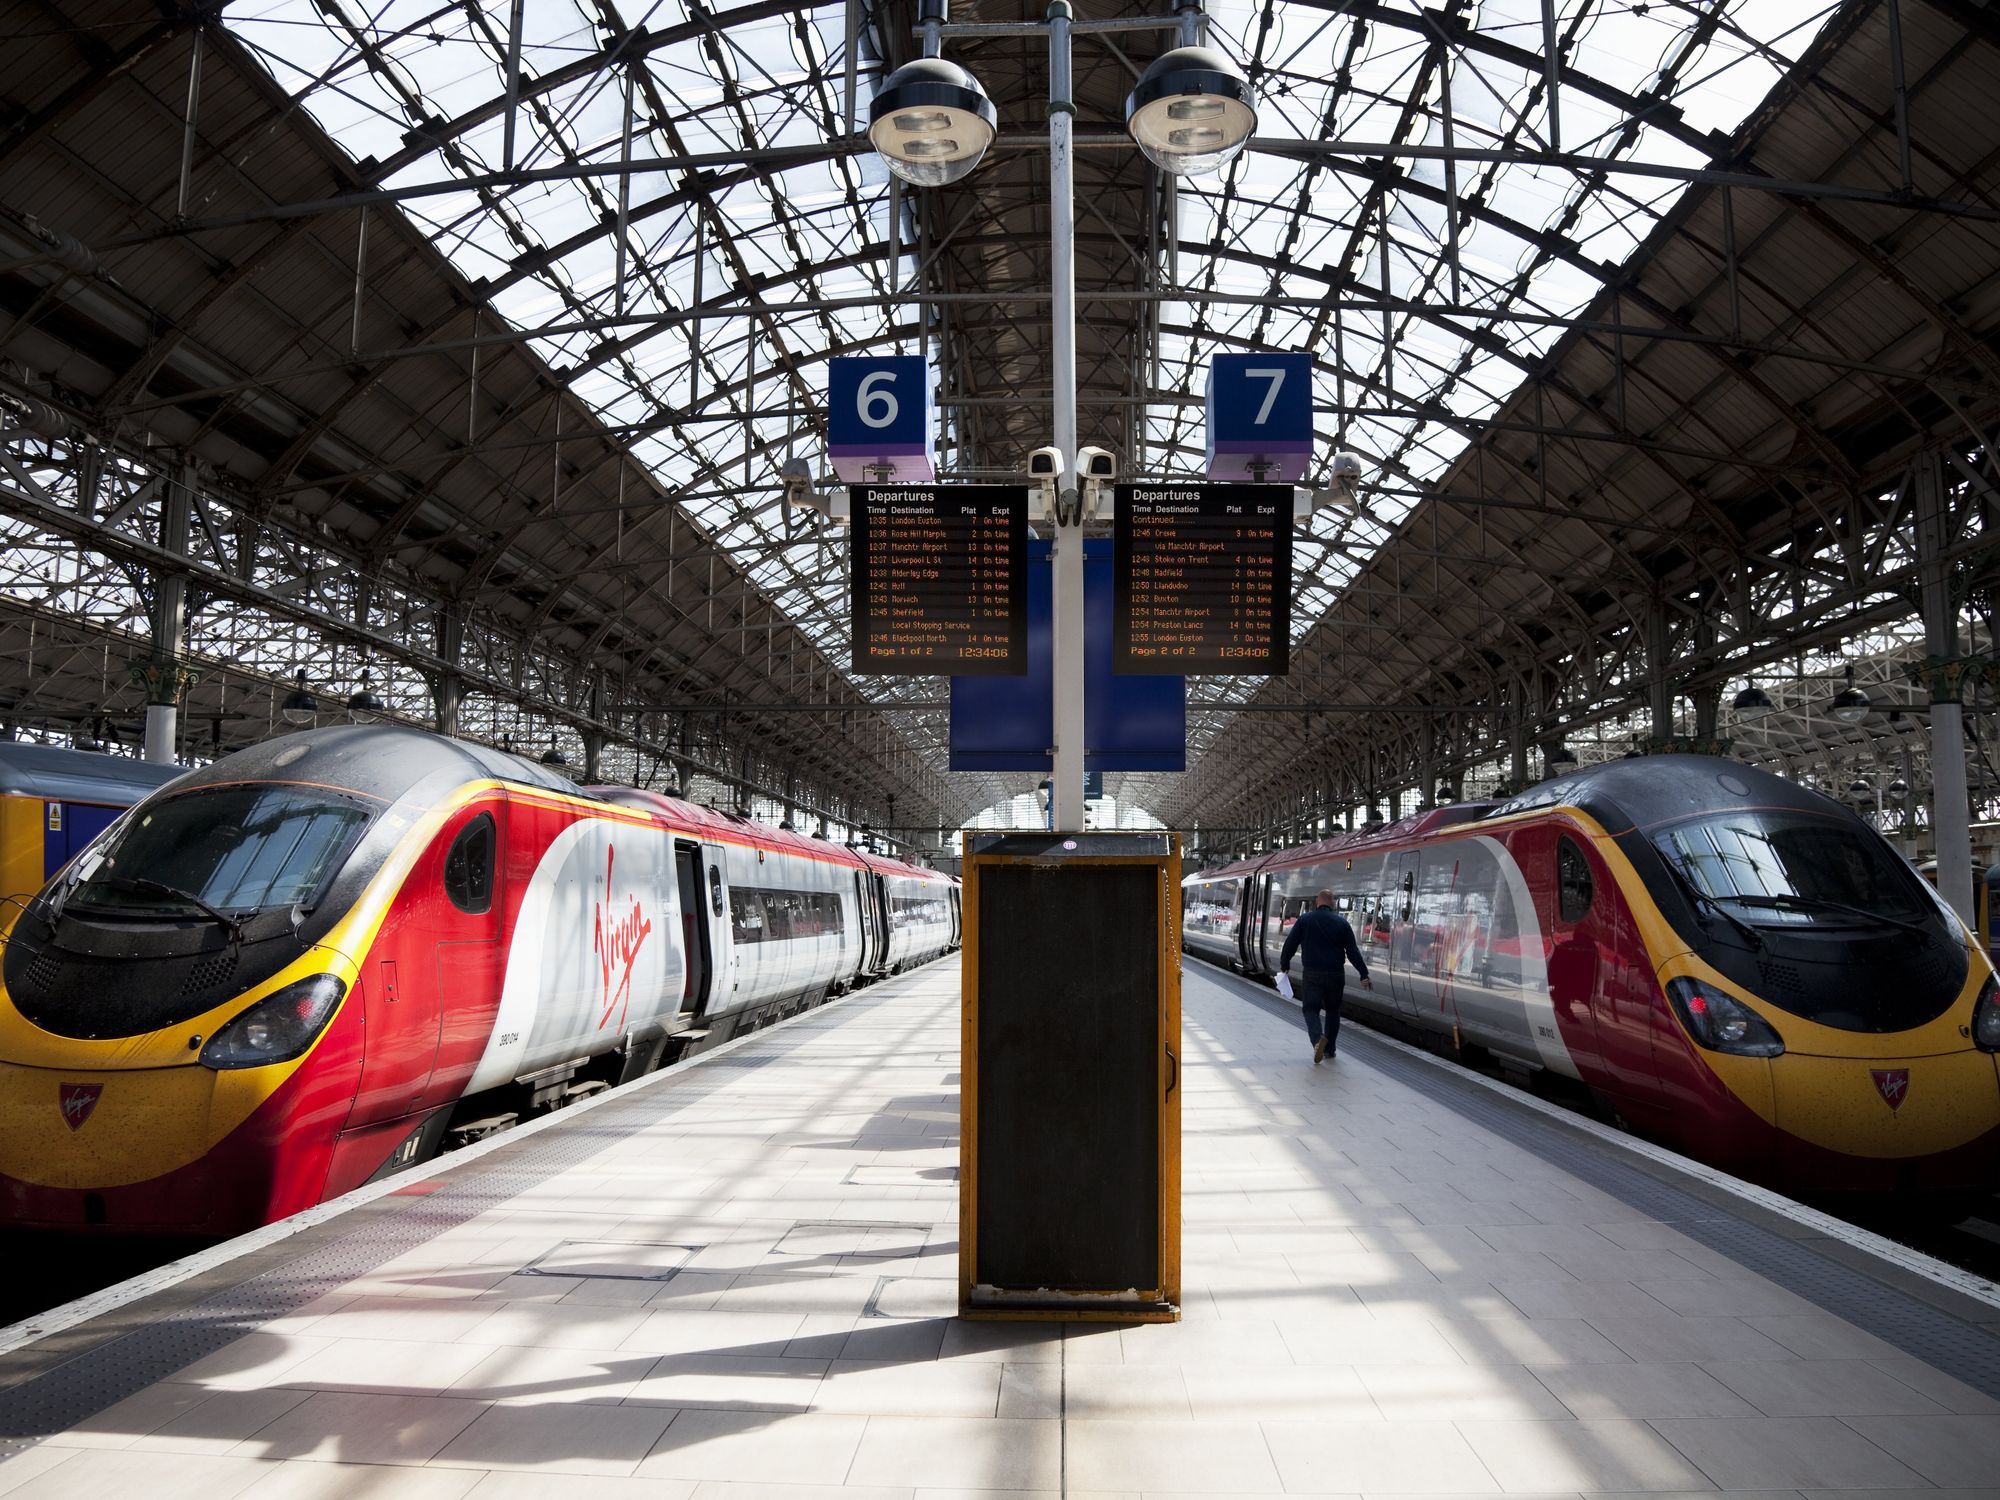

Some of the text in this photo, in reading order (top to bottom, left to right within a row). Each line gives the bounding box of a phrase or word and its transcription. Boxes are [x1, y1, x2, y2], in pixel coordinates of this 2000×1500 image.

[856, 371, 899, 428] 6
[1245, 368, 1286, 425] 7
[868, 490, 935, 503] Departures
[1133, 489, 1200, 503] Departures
[992, 507, 1009, 515] Expt
[1257, 506, 1275, 514] Expt
[923, 530, 946, 538] Marple
[984, 530, 992, 538] On
[923, 543, 948, 552] Airport
[968, 543, 976, 551] 13
[1168, 542, 1195, 550] Manchtr
[1200, 543, 1224, 551] Airport
[933, 556, 942, 564] St
[1154, 555, 1175, 563] Stoke
[892, 569, 920, 578] Alderley
[923, 570, 938, 578] Edge
[1231, 595, 1239, 603] 10
[1185, 608, 1210, 616] Airport
[913, 622, 943, 630] Stopping
[892, 635, 925, 643] Blackpool
[1245, 634, 1254, 642] On
[870, 647, 895, 656] Page
[959, 648, 1008, 657] 12:34:06
[1130, 647, 1156, 656] Page
[1220, 648, 1270, 656] 12:34:06
[595, 843, 651, 1036] Virgin
[1881, 1073, 1906, 1099] Virgin
[64, 1088, 96, 1118] Virgin
